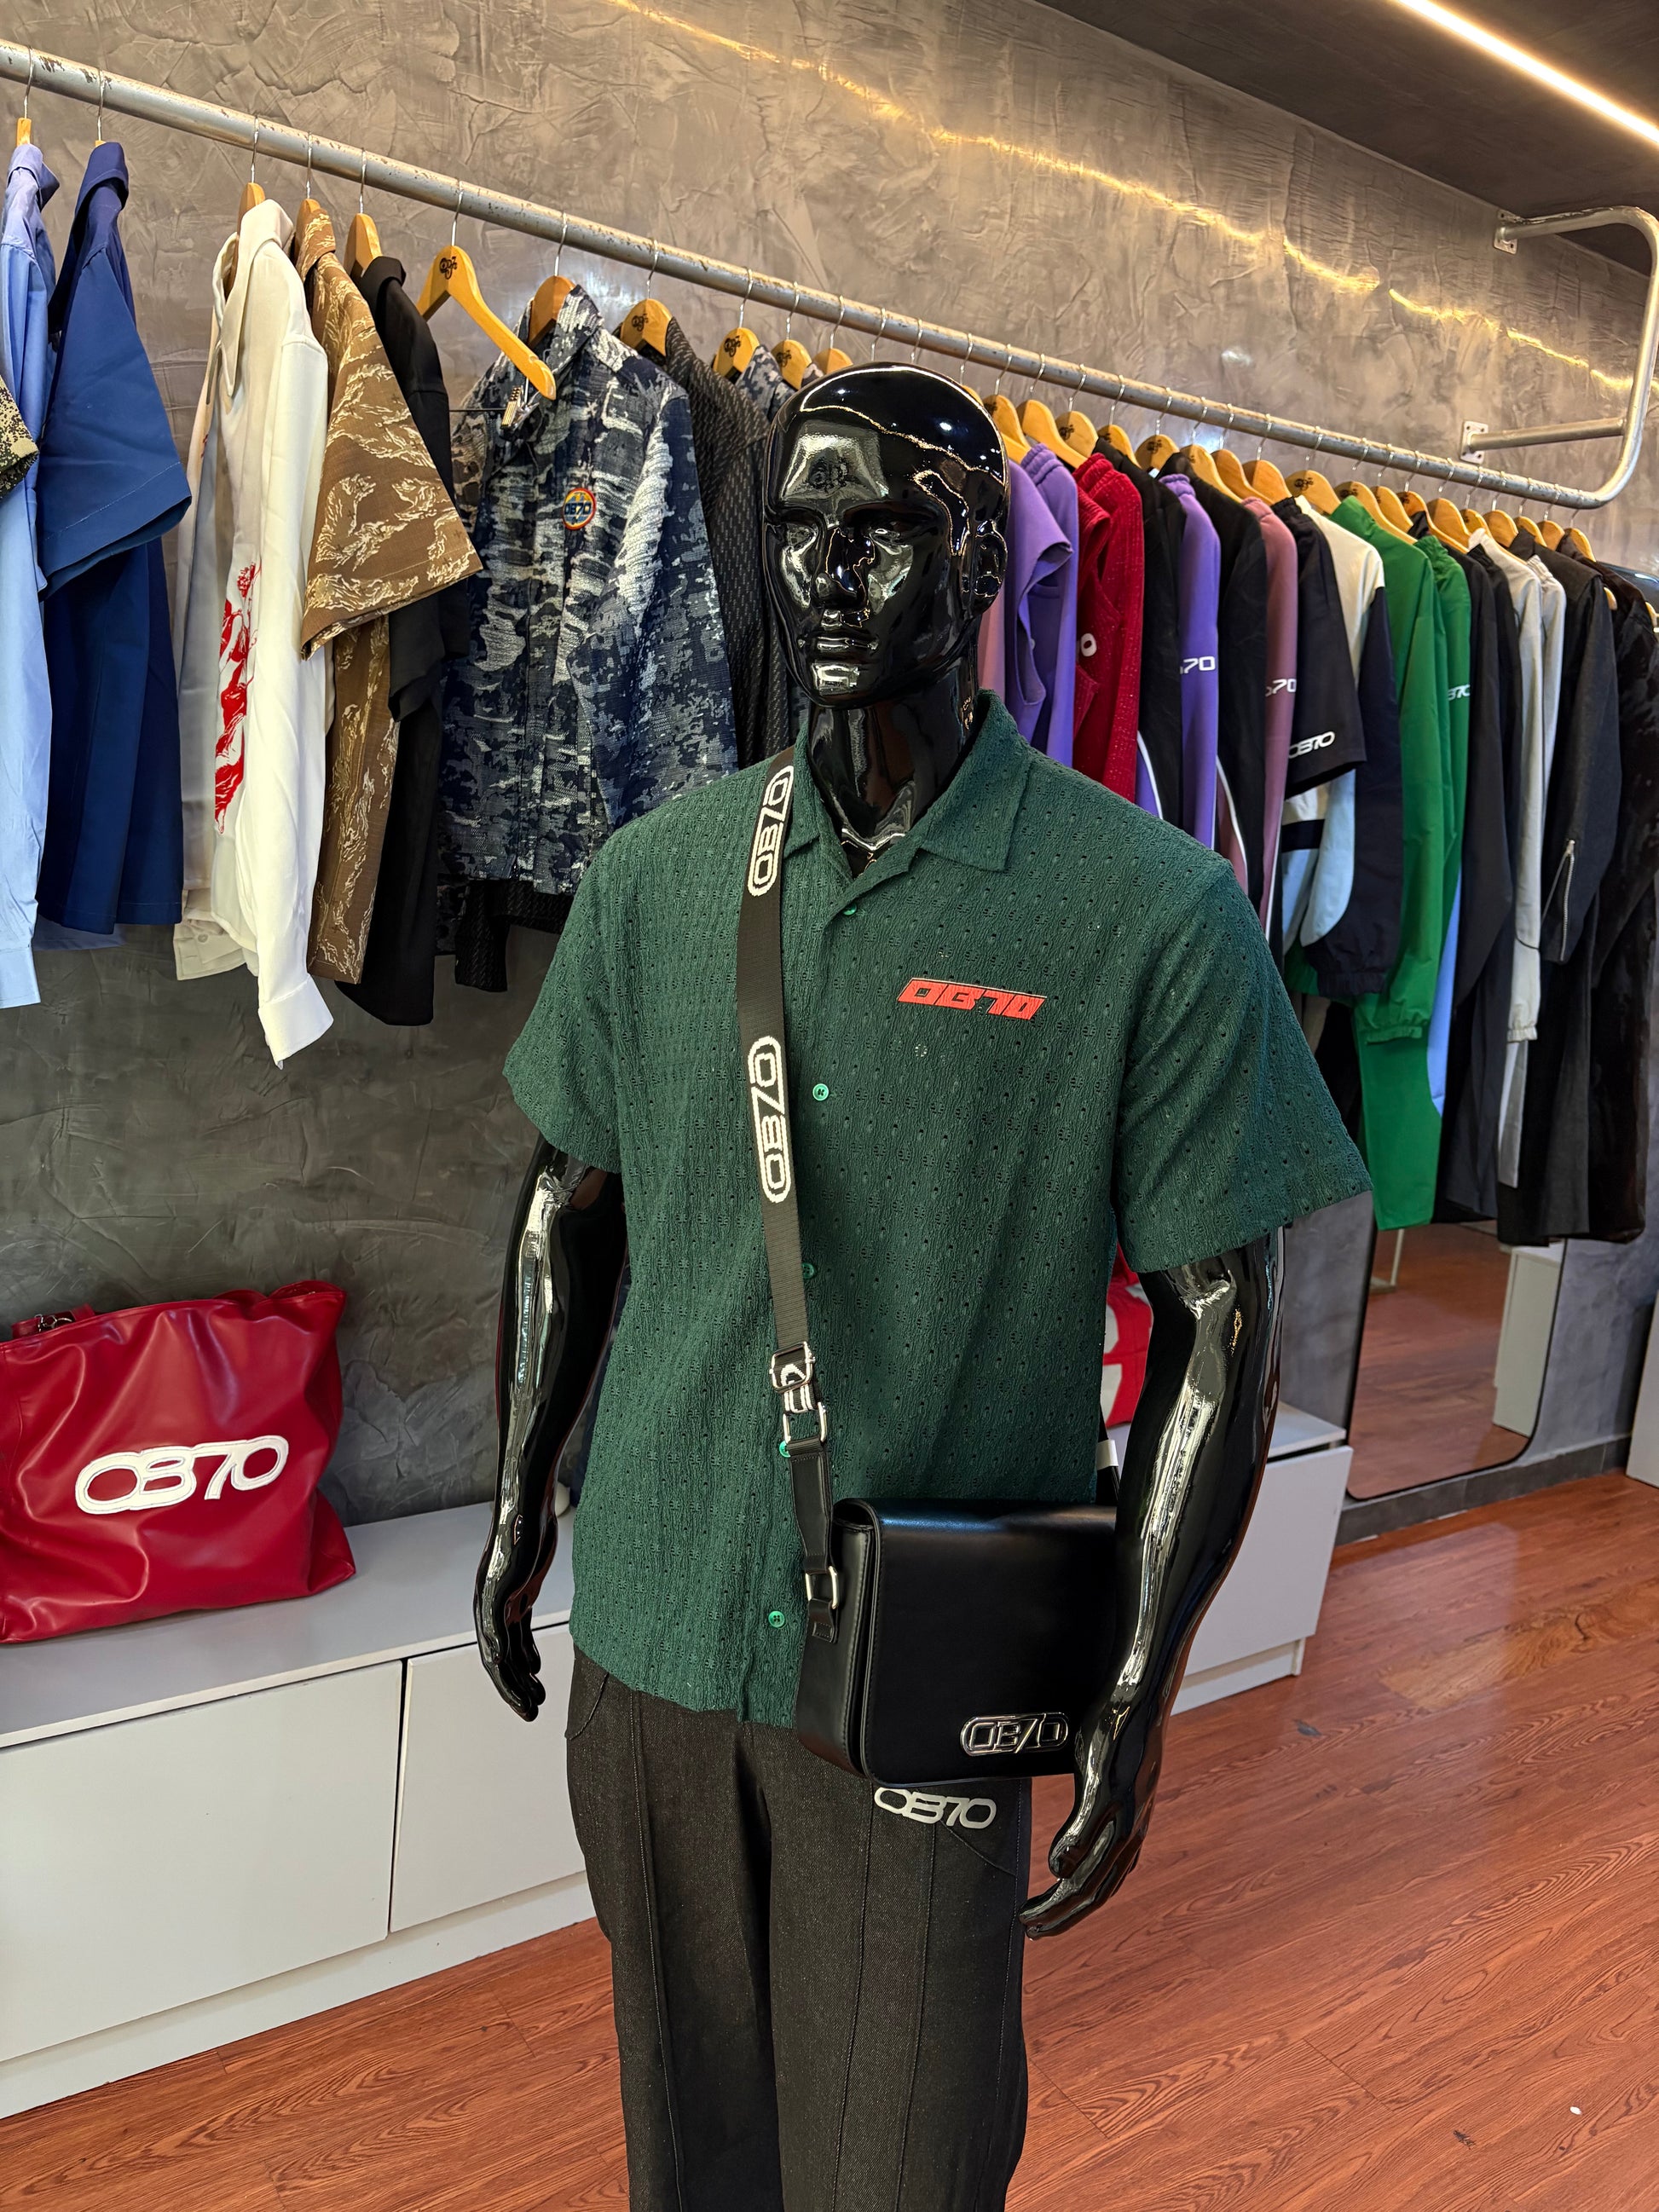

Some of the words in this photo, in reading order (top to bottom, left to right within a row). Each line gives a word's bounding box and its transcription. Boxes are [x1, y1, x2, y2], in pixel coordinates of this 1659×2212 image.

[748, 765, 794, 896] OB70
[897, 977, 1047, 1020] OB70
[748, 1036, 791, 1203] OB70
[75, 1435, 289, 1515] OB70
[961, 1712, 1068, 1756] OB70
[874, 1787, 997, 1829] OB70
